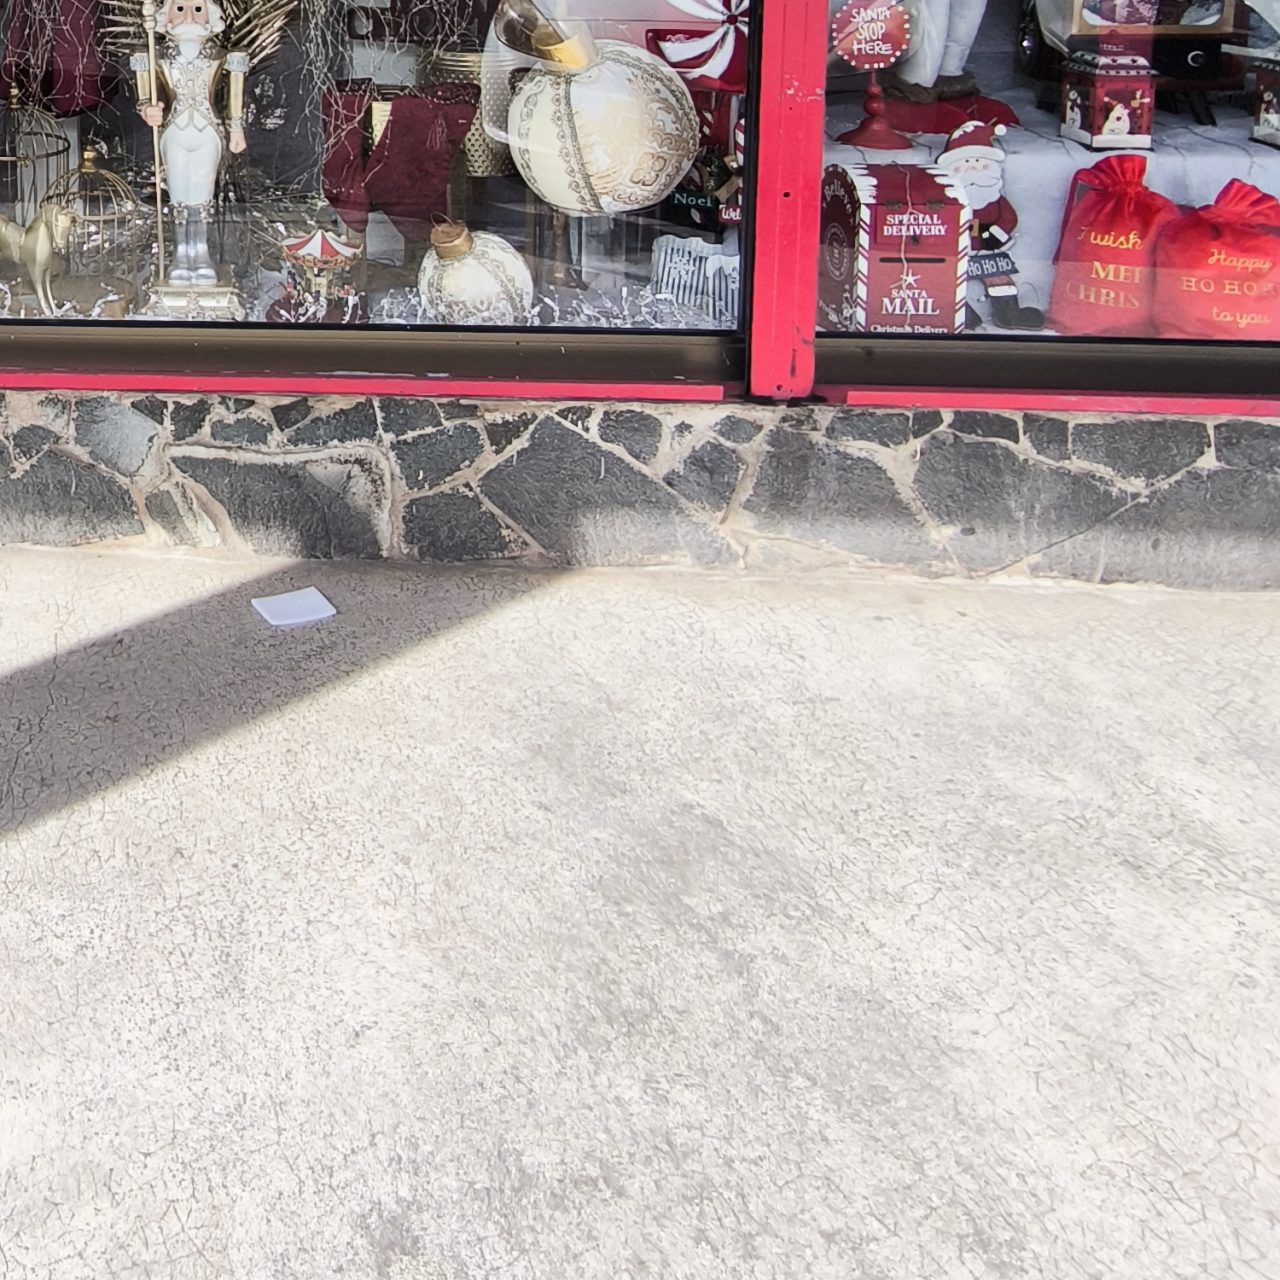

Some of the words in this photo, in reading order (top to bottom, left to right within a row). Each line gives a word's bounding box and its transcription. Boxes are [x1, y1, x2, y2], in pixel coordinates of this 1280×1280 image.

[850, 7, 891, 22] SANTA
[856, 21, 886, 40] STOP
[852, 40, 893, 56] HERE
[674, 193, 712, 207] Noel
[886, 214, 941, 225] SPECIAL
[883, 225, 948, 236] DELIVERY
[1090, 230, 1143, 250] wish
[968, 262, 981, 276] HO
[981, 259, 997, 274] HO
[996, 257, 1012, 271] HO
[1207, 248, 1273, 273] Happy
[891, 289, 928, 298] SANTA
[1181, 276, 1215, 293] HO
[1223, 280, 1257, 296] HO
[881, 298, 940, 315] MAIL
[1212, 305, 1234, 321] to
[1234, 312, 1272, 328] you
